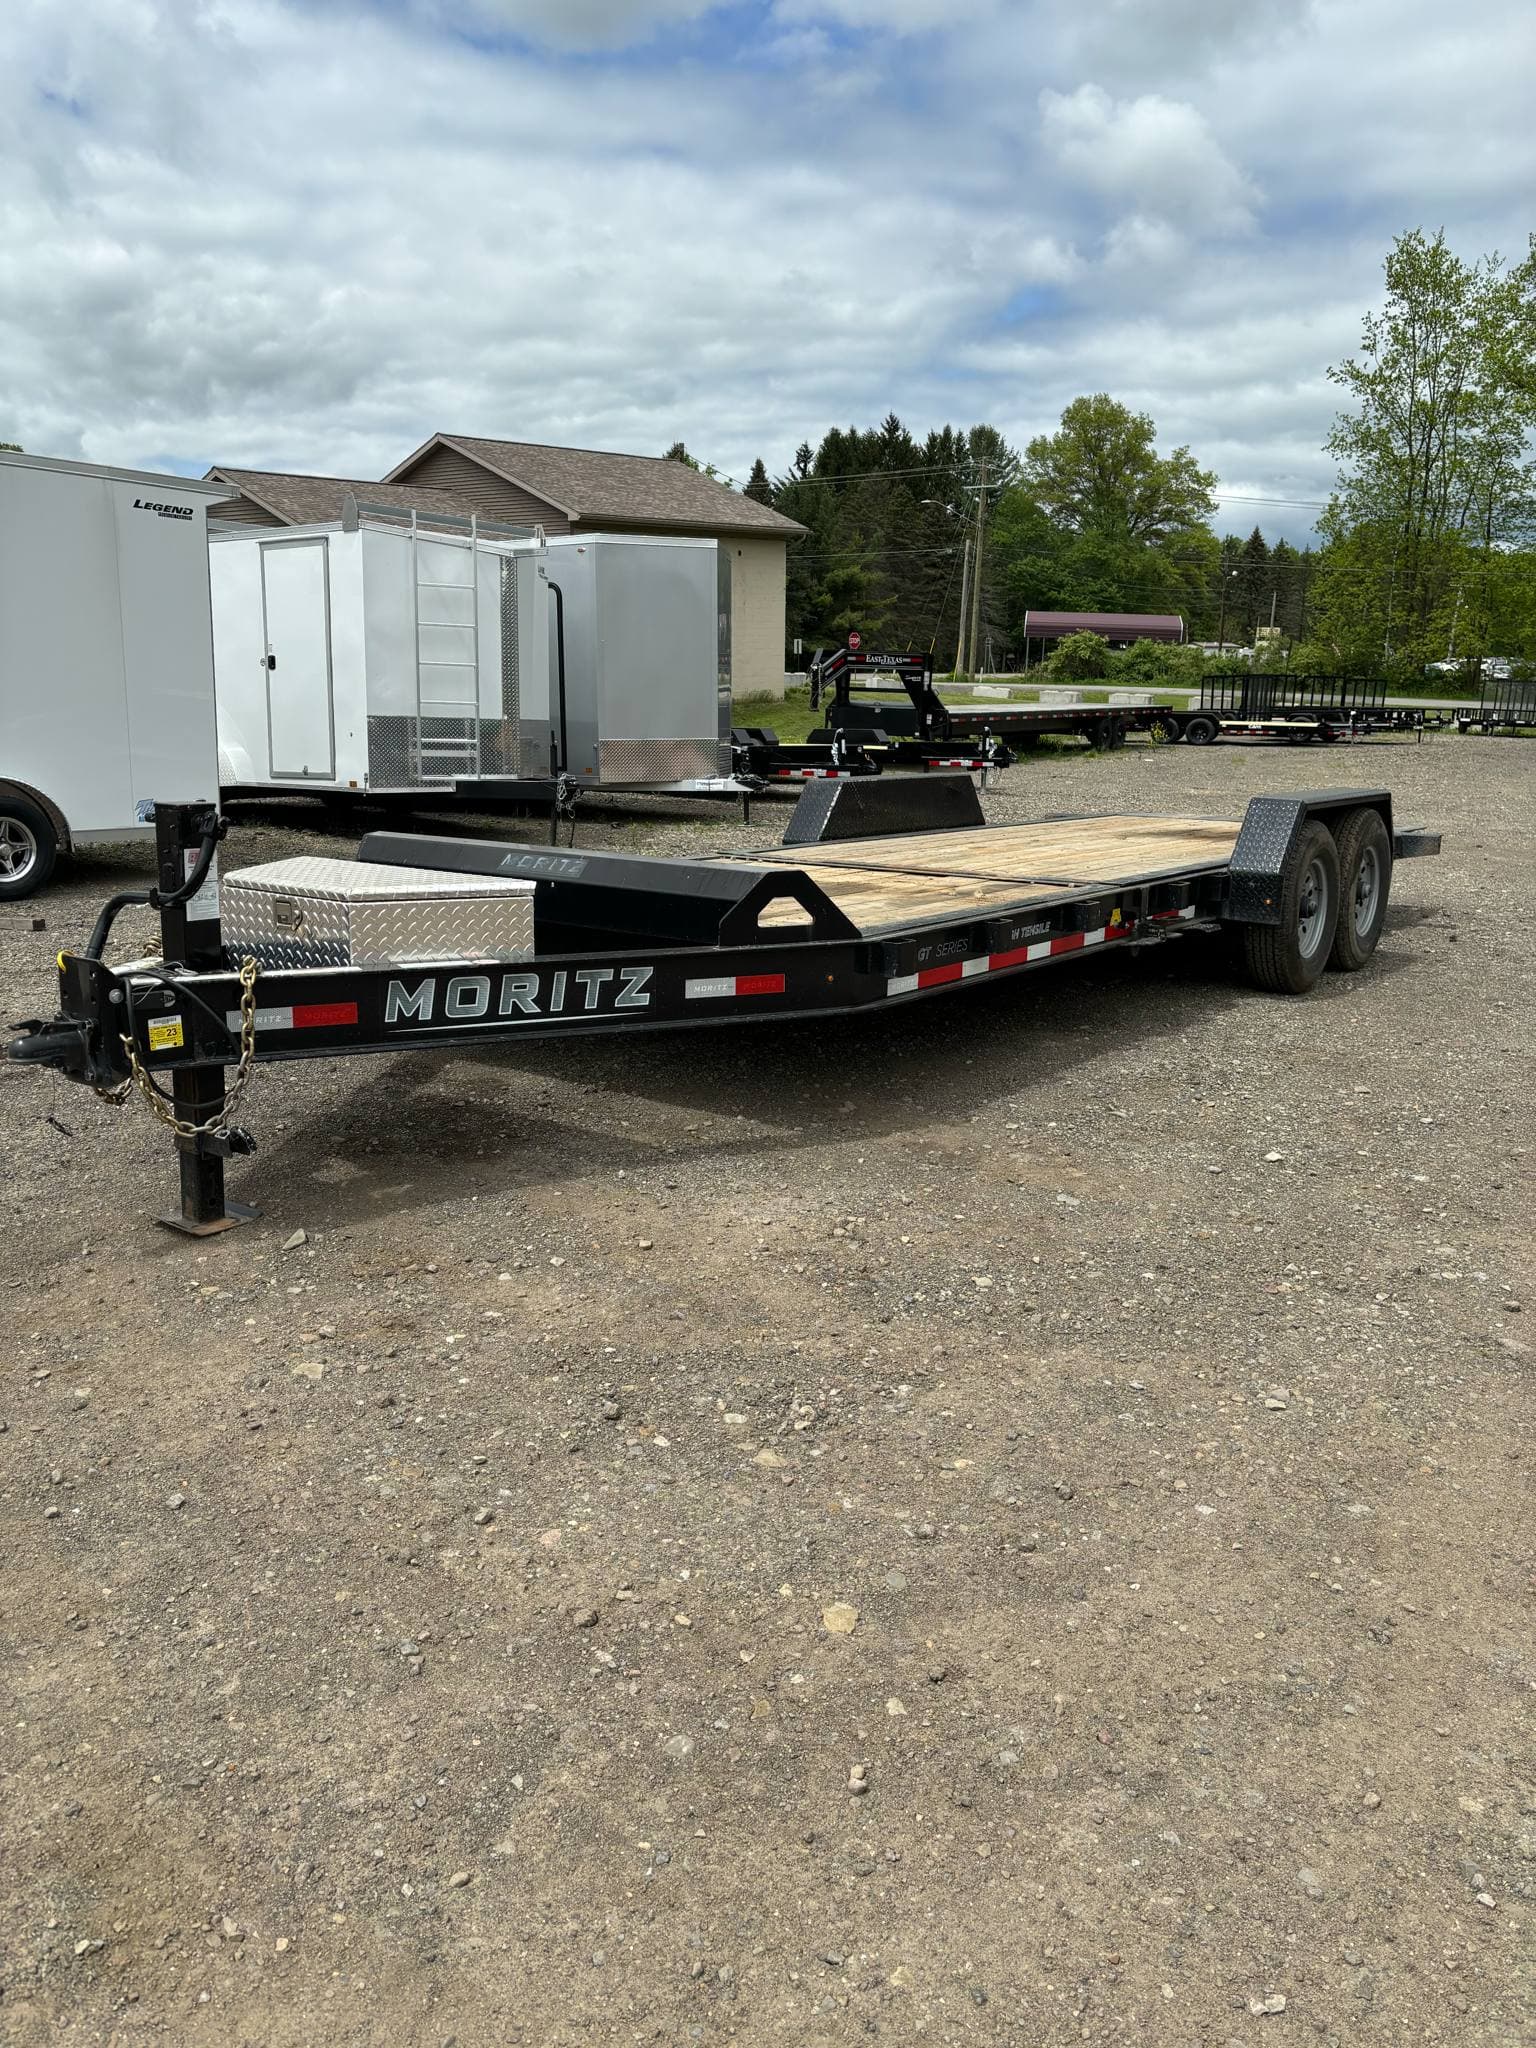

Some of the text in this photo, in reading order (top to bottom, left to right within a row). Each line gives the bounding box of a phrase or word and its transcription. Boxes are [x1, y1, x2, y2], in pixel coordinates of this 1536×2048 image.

[133, 499, 194, 515] LEGEND
[866, 654, 903, 664] EAST TEXAS
[500, 853, 585, 874] MORITZ
[918, 939, 969, 961] GT SERIES
[384, 966, 654, 1023] MORITZ
[693, 983, 728, 993] MORITZ
[238, 1015, 282, 1025] MRITZ
[166, 1027, 178, 1037] 23
